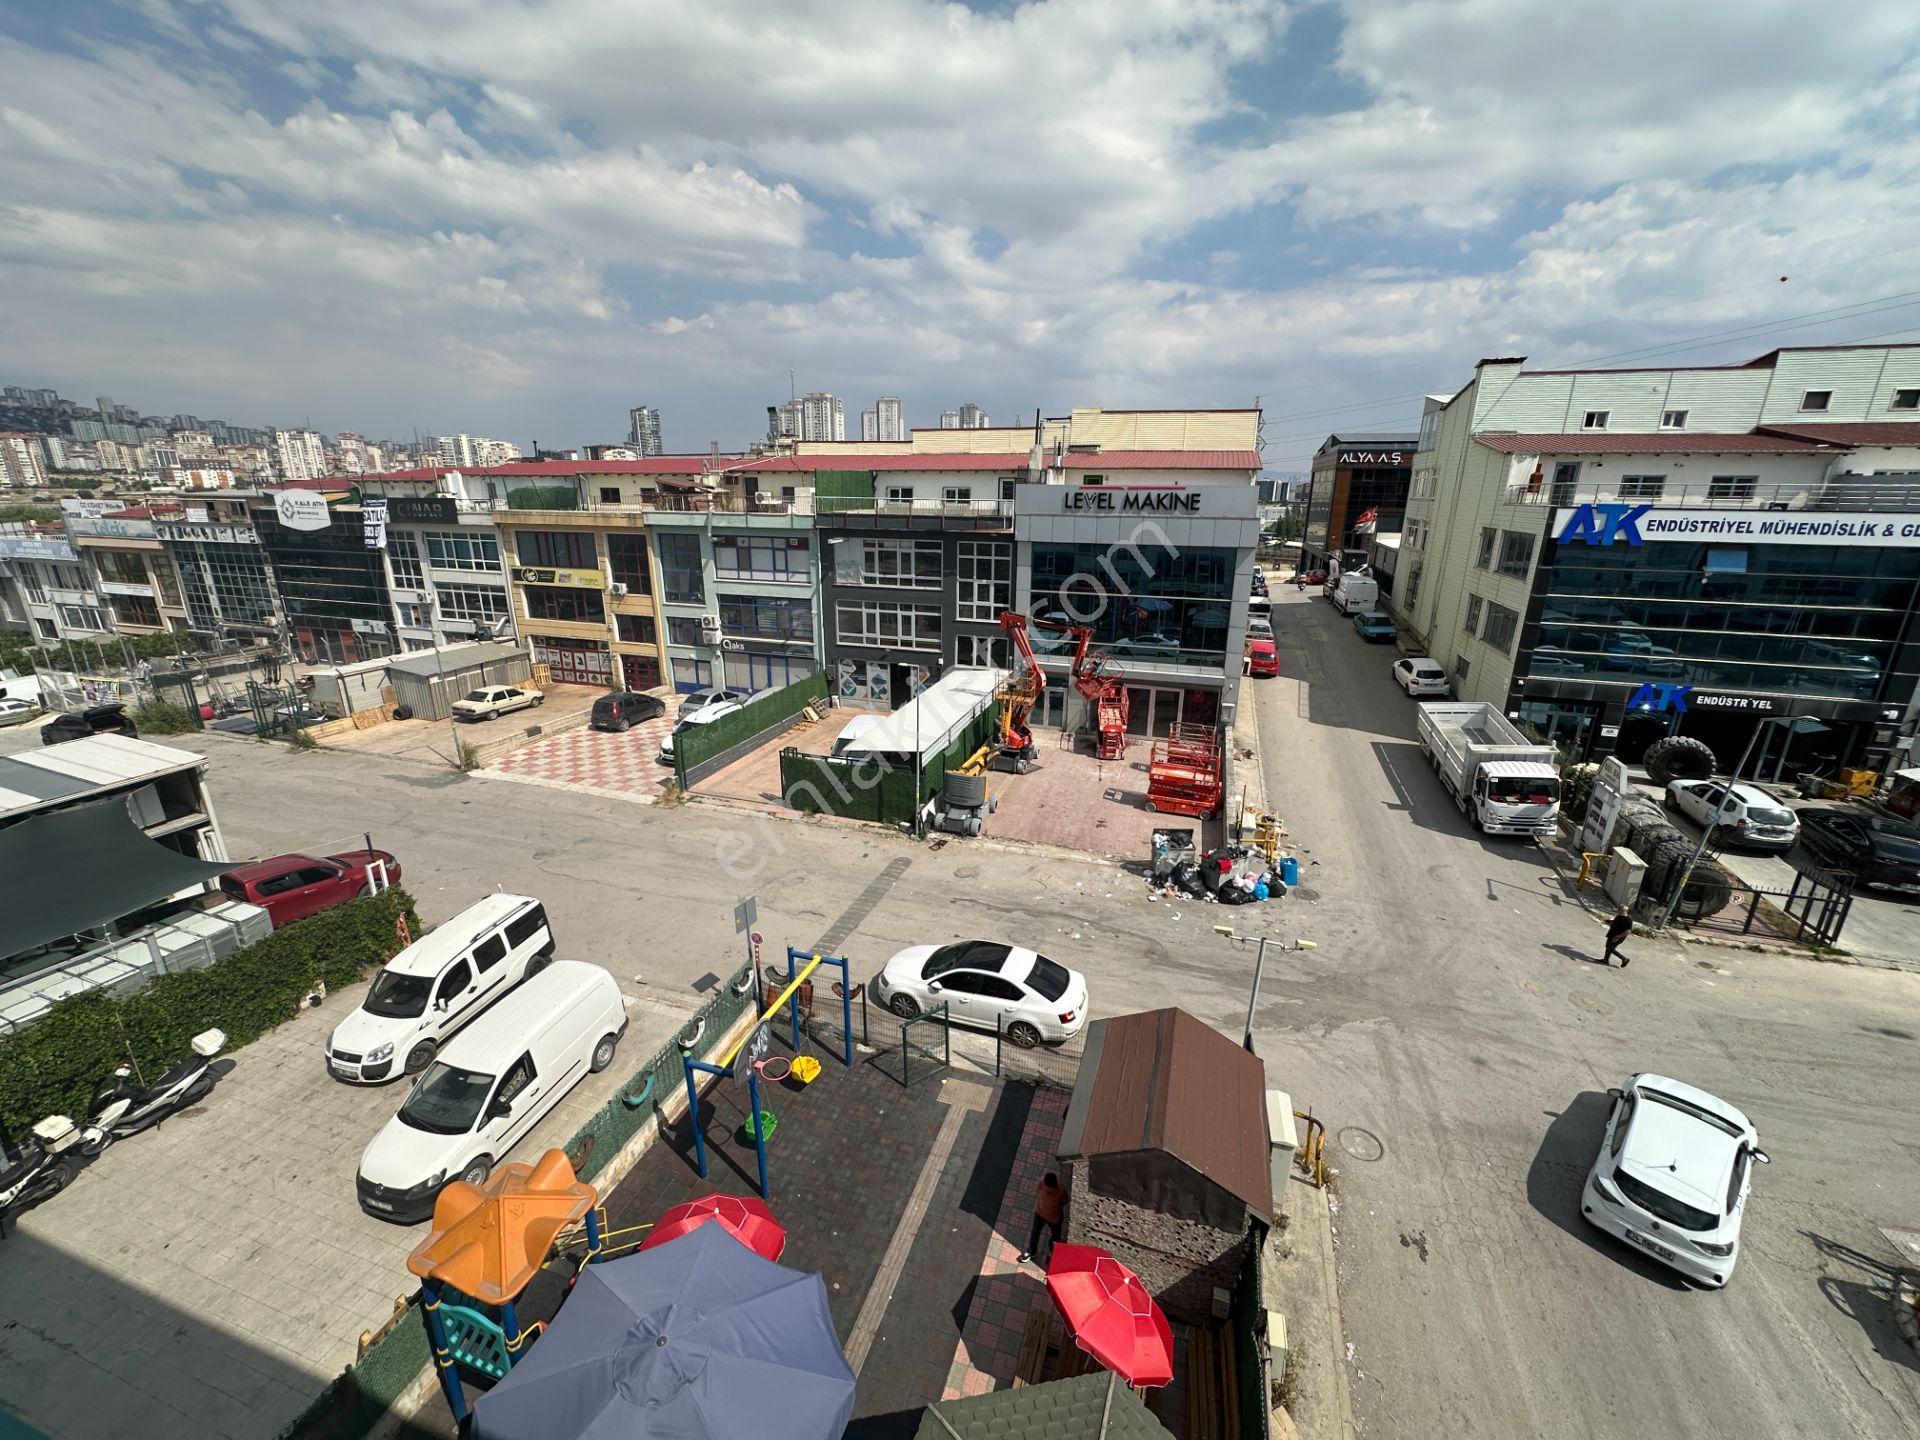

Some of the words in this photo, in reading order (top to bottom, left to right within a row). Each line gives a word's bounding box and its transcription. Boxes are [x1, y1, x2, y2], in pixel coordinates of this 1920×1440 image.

[1339, 452, 1374, 463] ALYA
[1377, 452, 1404, 466] A.Ş.
[1064, 492, 1116, 511] LEVEL
[1122, 491, 1201, 512] MAKİNE
[1557, 503, 1655, 547] ATK
[1646, 517, 1754, 534] ENDÜSTRİYEL
[1759, 519, 1879, 537] MÜHENDİSLİK
[1881, 523, 1894, 537] &
[1627, 682, 1694, 713] ATK
[1696, 695, 1773, 710] ENDÜSTRYEL
